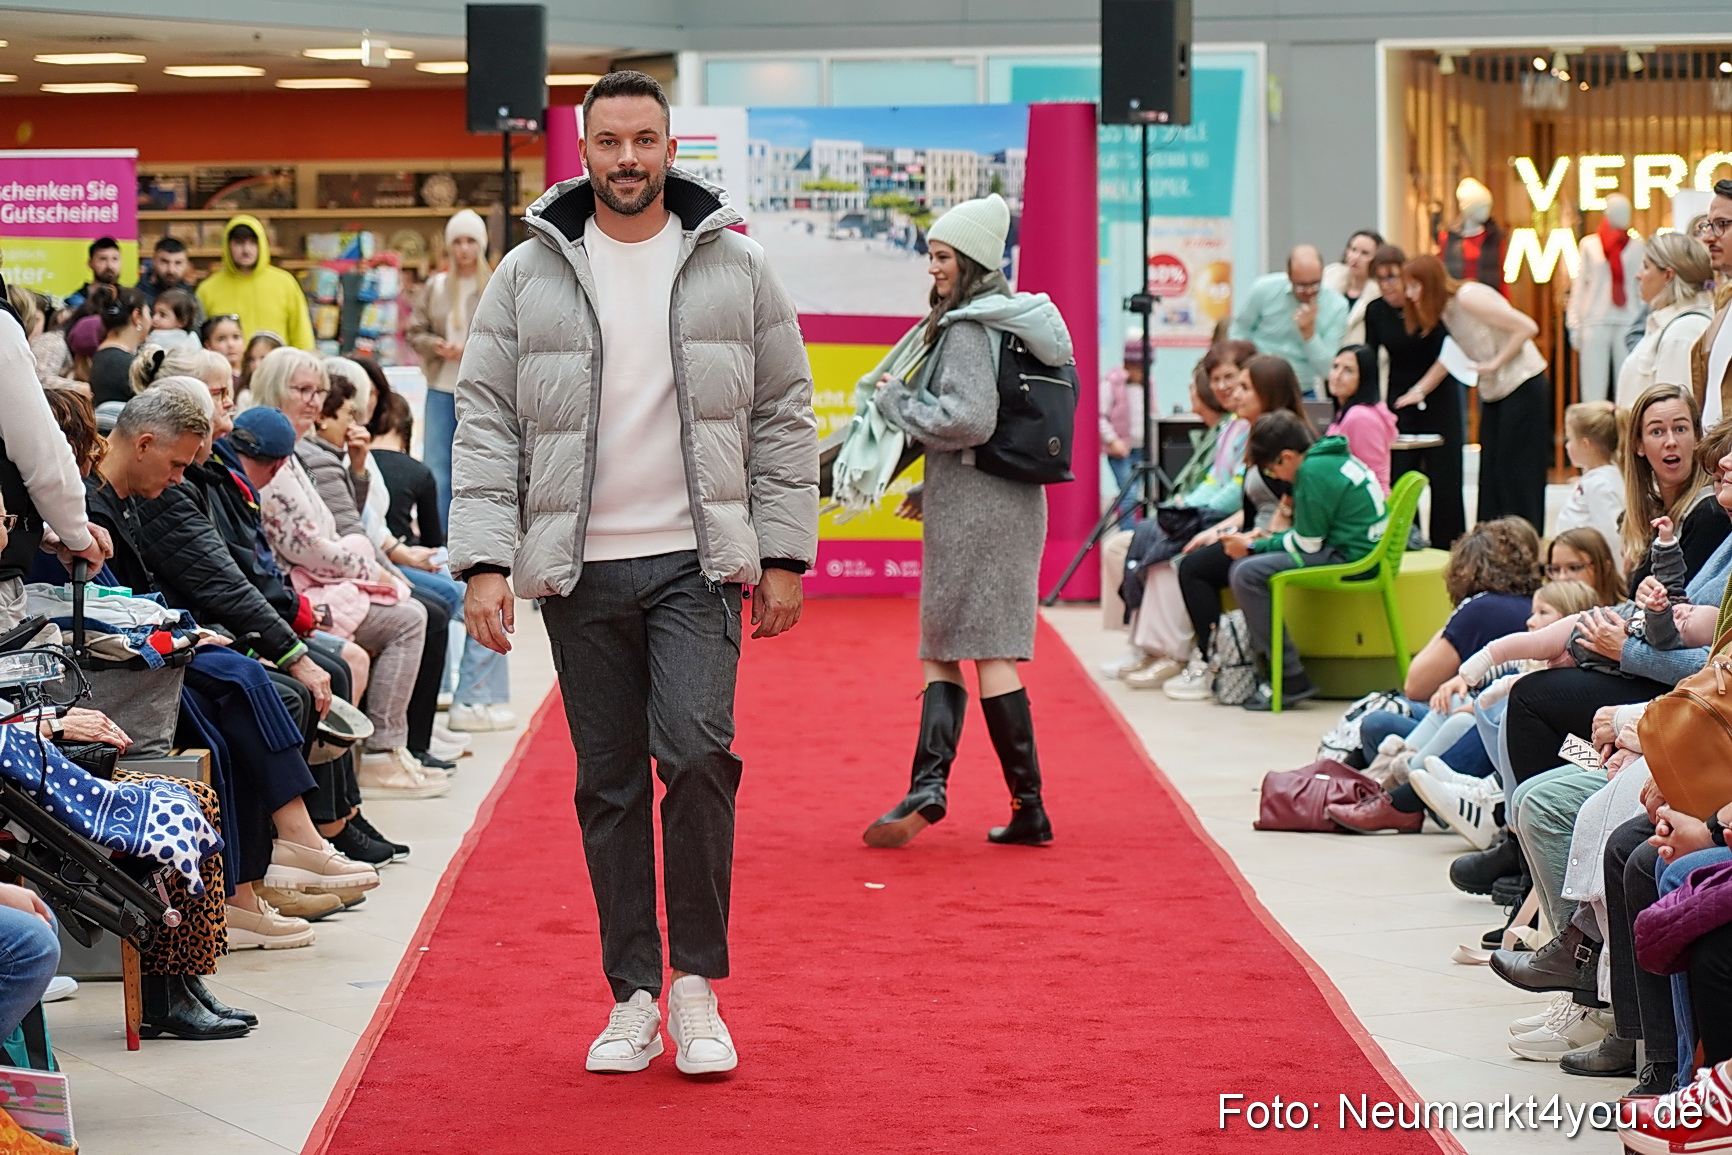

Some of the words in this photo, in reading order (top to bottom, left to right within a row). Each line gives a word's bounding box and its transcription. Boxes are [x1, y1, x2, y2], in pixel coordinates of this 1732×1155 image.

[0, 180, 84, 201] chenken
[87, 180, 118, 201] Sie
[1, 202, 119, 223] Gutscheine!
